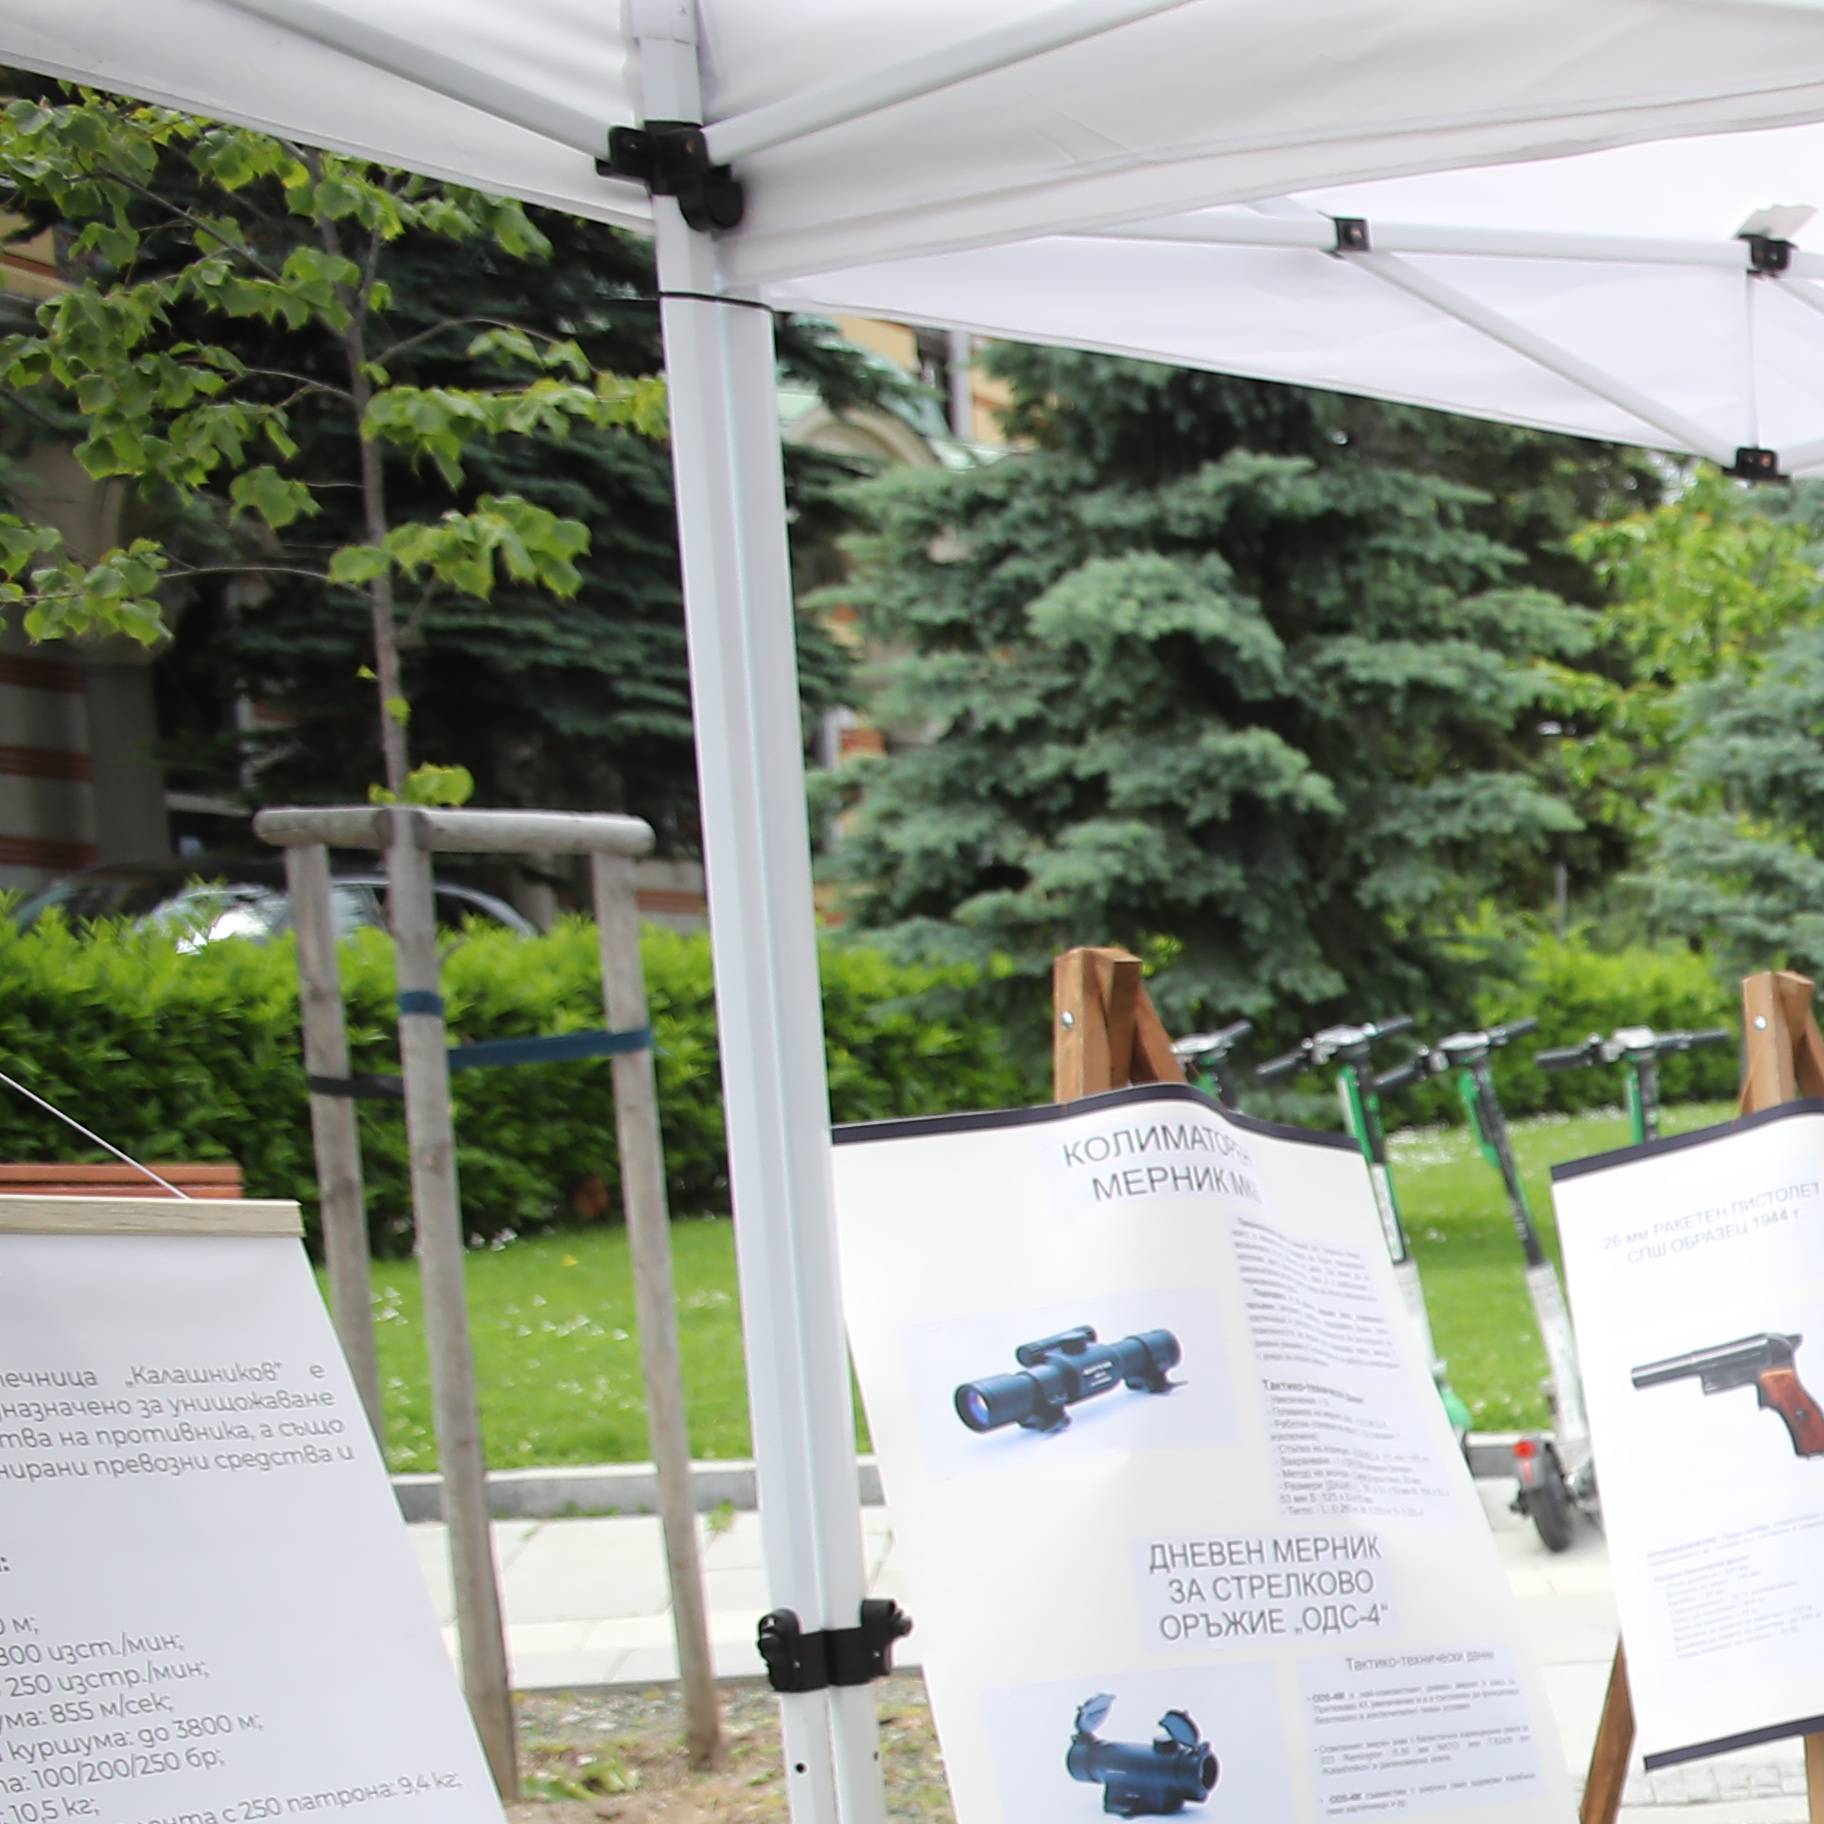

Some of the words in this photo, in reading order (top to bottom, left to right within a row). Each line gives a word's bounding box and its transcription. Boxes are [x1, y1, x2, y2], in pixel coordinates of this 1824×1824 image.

[1092, 1165, 1229, 1202] МЕРНИК
[1731, 1181, 1821, 1213] ПИСТОЛЕТ
[1752, 1207, 1789, 1230] 1944
[308, 1363, 325, 1379] е
[0, 1400, 131, 1422] назначено
[138, 1401, 164, 1419] за
[169, 1390, 337, 1418] унищожаване
[59, 1430, 90, 1447] на
[95, 1421, 256, 1449] противника,
[259, 1423, 274, 1439] а
[278, 1417, 345, 1438] също
[94, 1452, 211, 1480] превозни
[214, 1444, 333, 1472] средства
[340, 1446, 355, 1462] и
[1149, 1539, 1265, 1574] ДНЕВЕН
[1273, 1535, 1381, 1563] МЕРНИК
[1168, 1578, 1206, 1604] ЗА
[1212, 1568, 1374, 1601] СТРЕЛКОВО
[11, 1616, 39, 1635] м;
[1159, 1608, 1286, 1641] ОРЪЖИЕ
[47, 1630, 185, 1665] изст./мин;
[5, 1673, 51, 1698] 250
[57, 1659, 211, 1696] изстр./мин;
[0, 1708, 47, 1737] ма:
[49, 1700, 94, 1725] 855
[100, 1691, 174, 1720] м/сек;
[7, 1729, 134, 1765] куршума:
[137, 1726, 169, 1749] до
[172, 1713, 233, 1740] 3800
[237, 1712, 264, 1732] м;
[33, 1750, 180, 1789] 100/200/250
[184, 1746, 226, 1771] бр;
[8, 1799, 59, 1824] 10,5
[61, 1796, 99, 1817] кг;
[222, 1806, 236, 1823] с
[241, 1796, 281, 1821] 250
[287, 1783, 397, 1812] патрона:
[397, 1774, 432, 1797] 9,4
